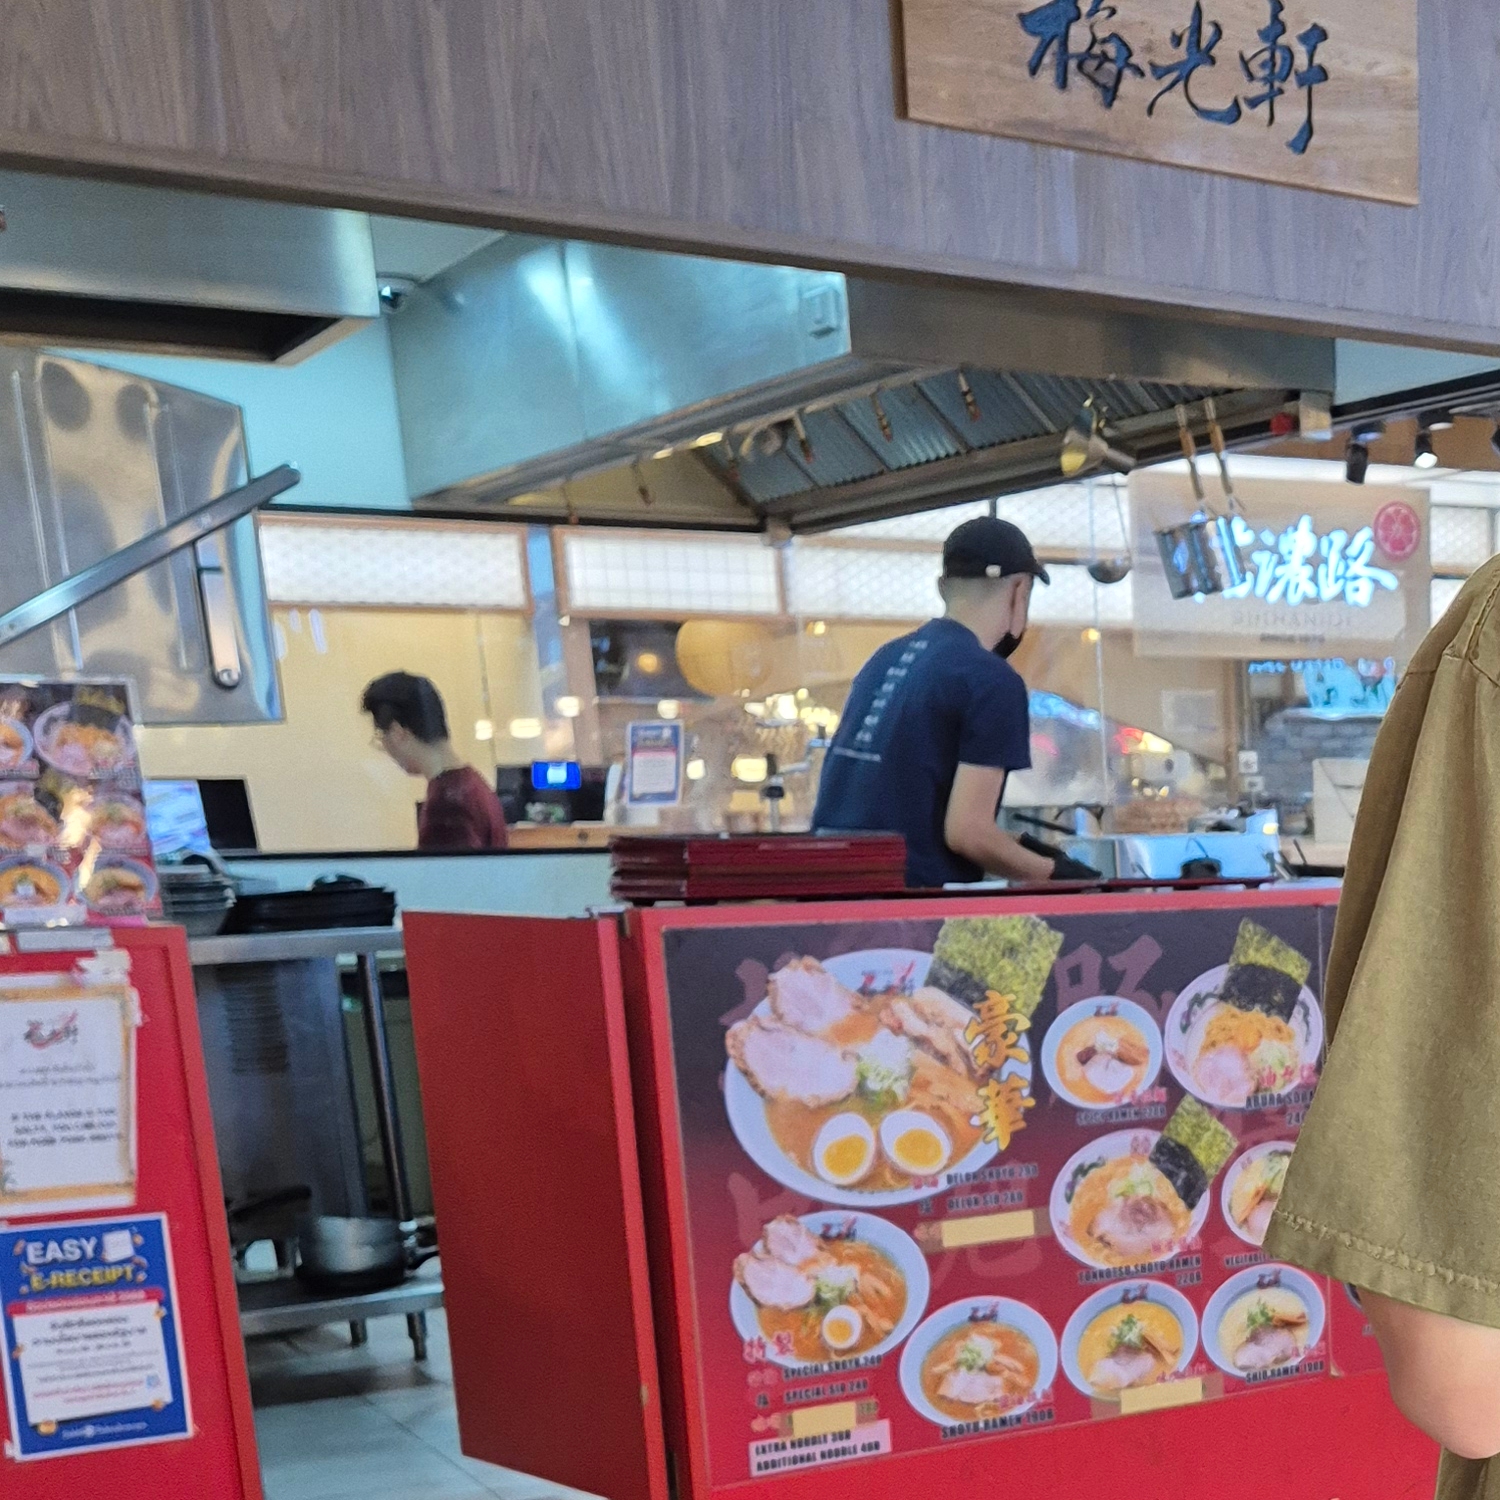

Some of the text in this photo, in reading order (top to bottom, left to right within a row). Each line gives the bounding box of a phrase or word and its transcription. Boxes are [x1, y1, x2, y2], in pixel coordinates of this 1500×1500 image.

[26, 1235, 98, 1265] EASY
[1168, 1256, 1201, 1270] RAMEN
[30, 1266, 134, 1291] E-RECEIPT
[1269, 1364, 1301, 1378] RAMEN
[941, 1421, 980, 1439] SHOYU
[983, 1415, 1022, 1431] RAMEN
[755, 1440, 787, 1456] EXTRA
[790, 1434, 829, 1449] NOODLE
[756, 1452, 817, 1472] ADDITIONAL
[820, 1445, 858, 1461] NOODLE
